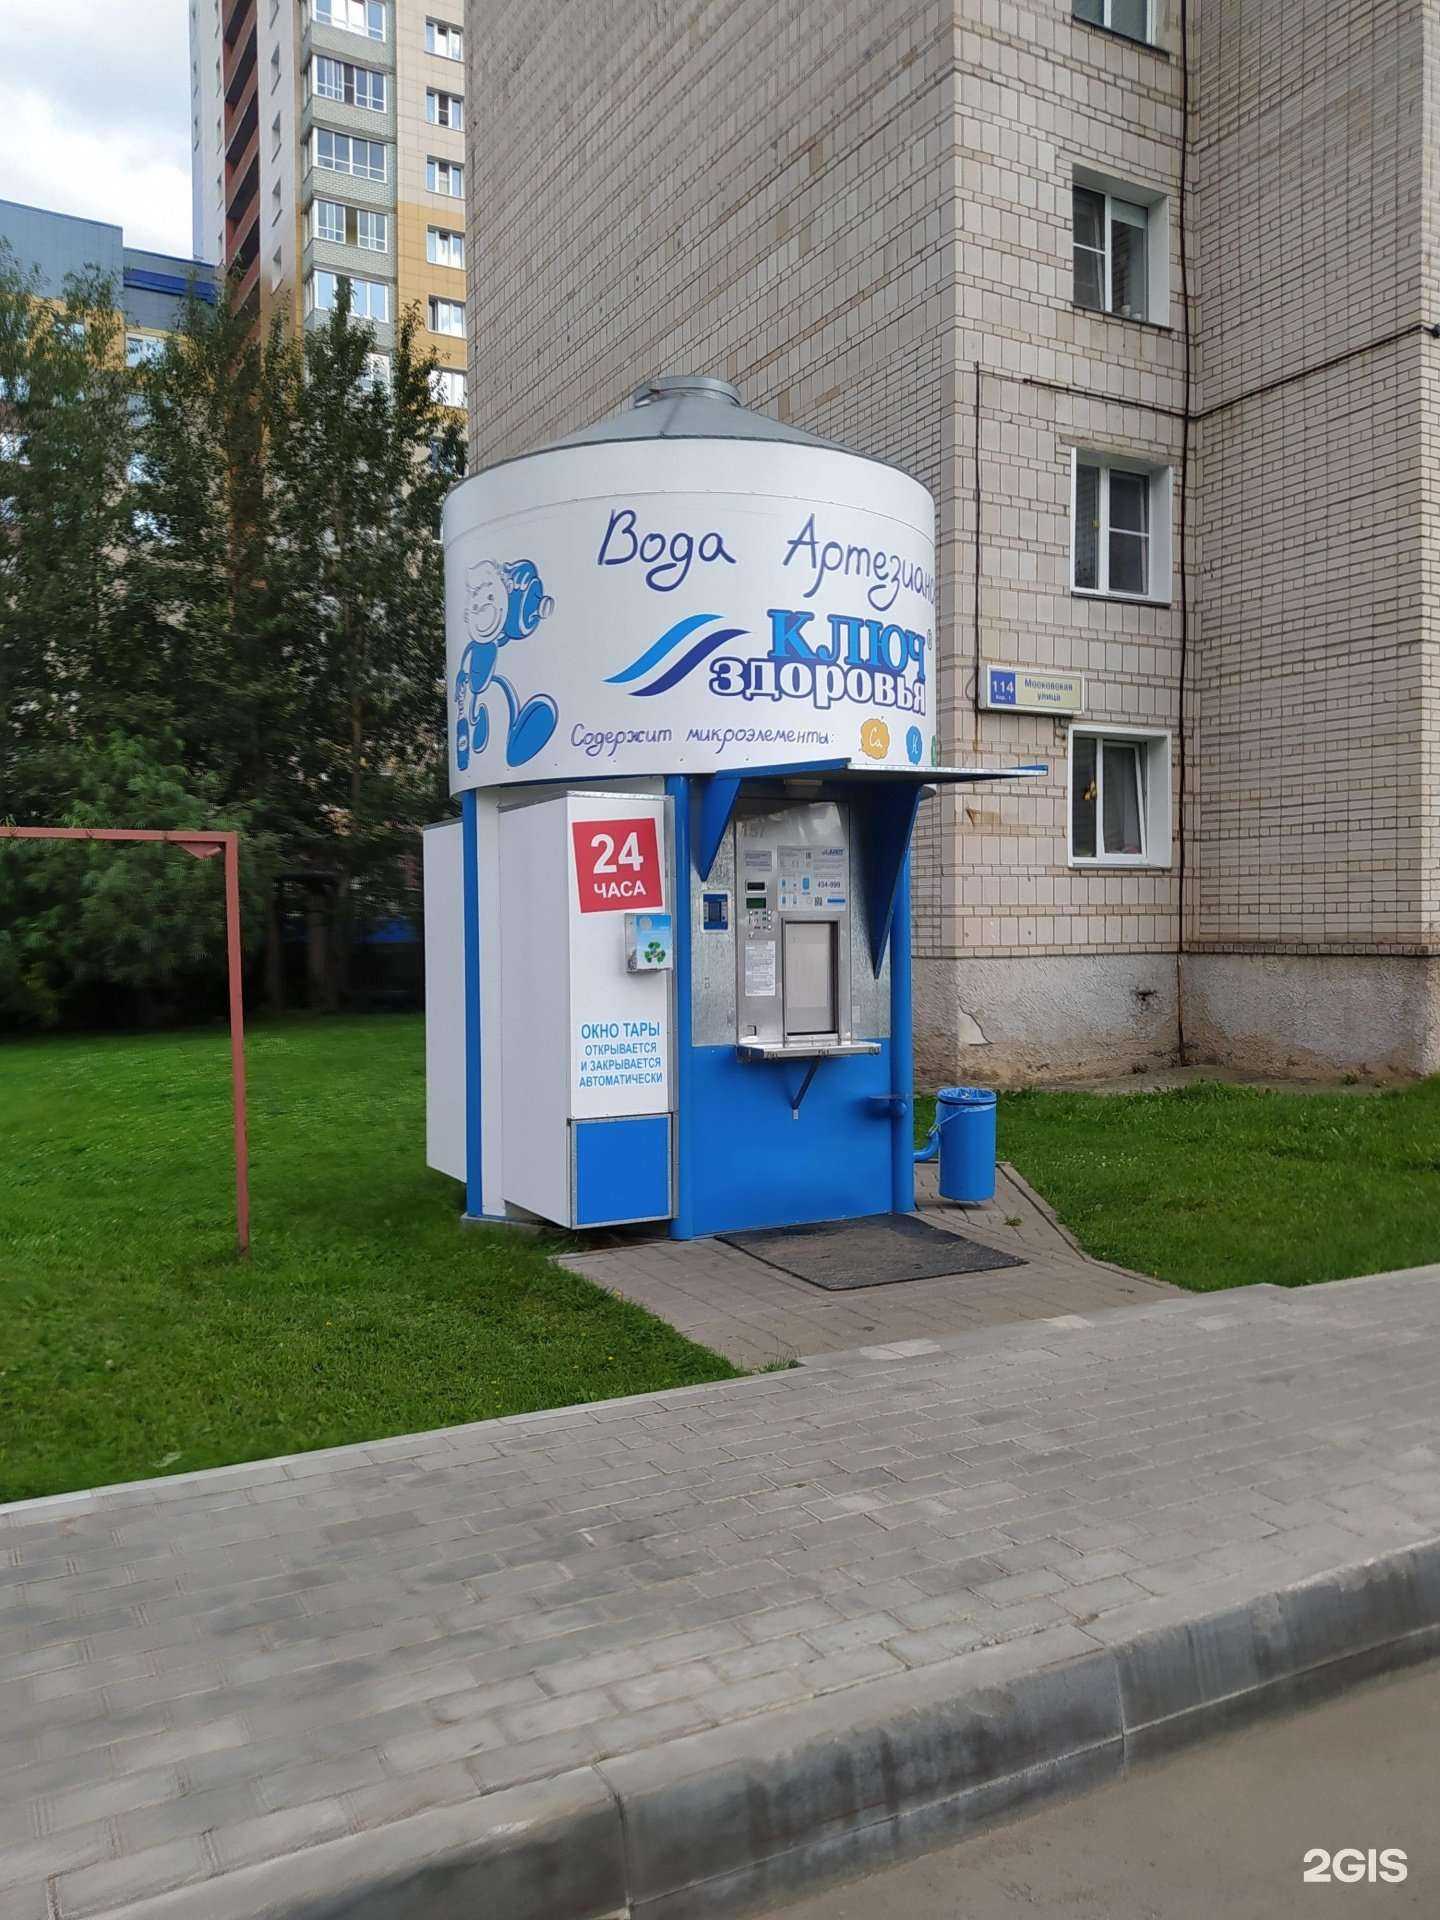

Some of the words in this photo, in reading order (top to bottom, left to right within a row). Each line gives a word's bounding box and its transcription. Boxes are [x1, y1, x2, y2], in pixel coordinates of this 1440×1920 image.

[598, 508, 737, 592] Вода
[767, 608, 925, 681] КЛЮЧ
[993, 681, 1014, 693] 114
[1024, 678, 1073, 692] Московская
[1037, 692, 1061, 702] улица
[571, 723, 673, 757] Содержит
[686, 727, 834, 755] микроэлементы:
[590, 831, 644, 875] 24
[593, 880, 647, 899] ЧАСА
[581, 1023, 619, 1039] ОКНО
[623, 1021, 660, 1037] ТАРЫ
[585, 1042, 657, 1056] ОТКРЫВАЕТСЯ
[580, 1061, 588, 1072] И
[590, 1057, 661, 1071] ЗАКРЫВАЕТСЯ
[579, 1072, 663, 1087] АВТОМАТИЧЕСКИ
